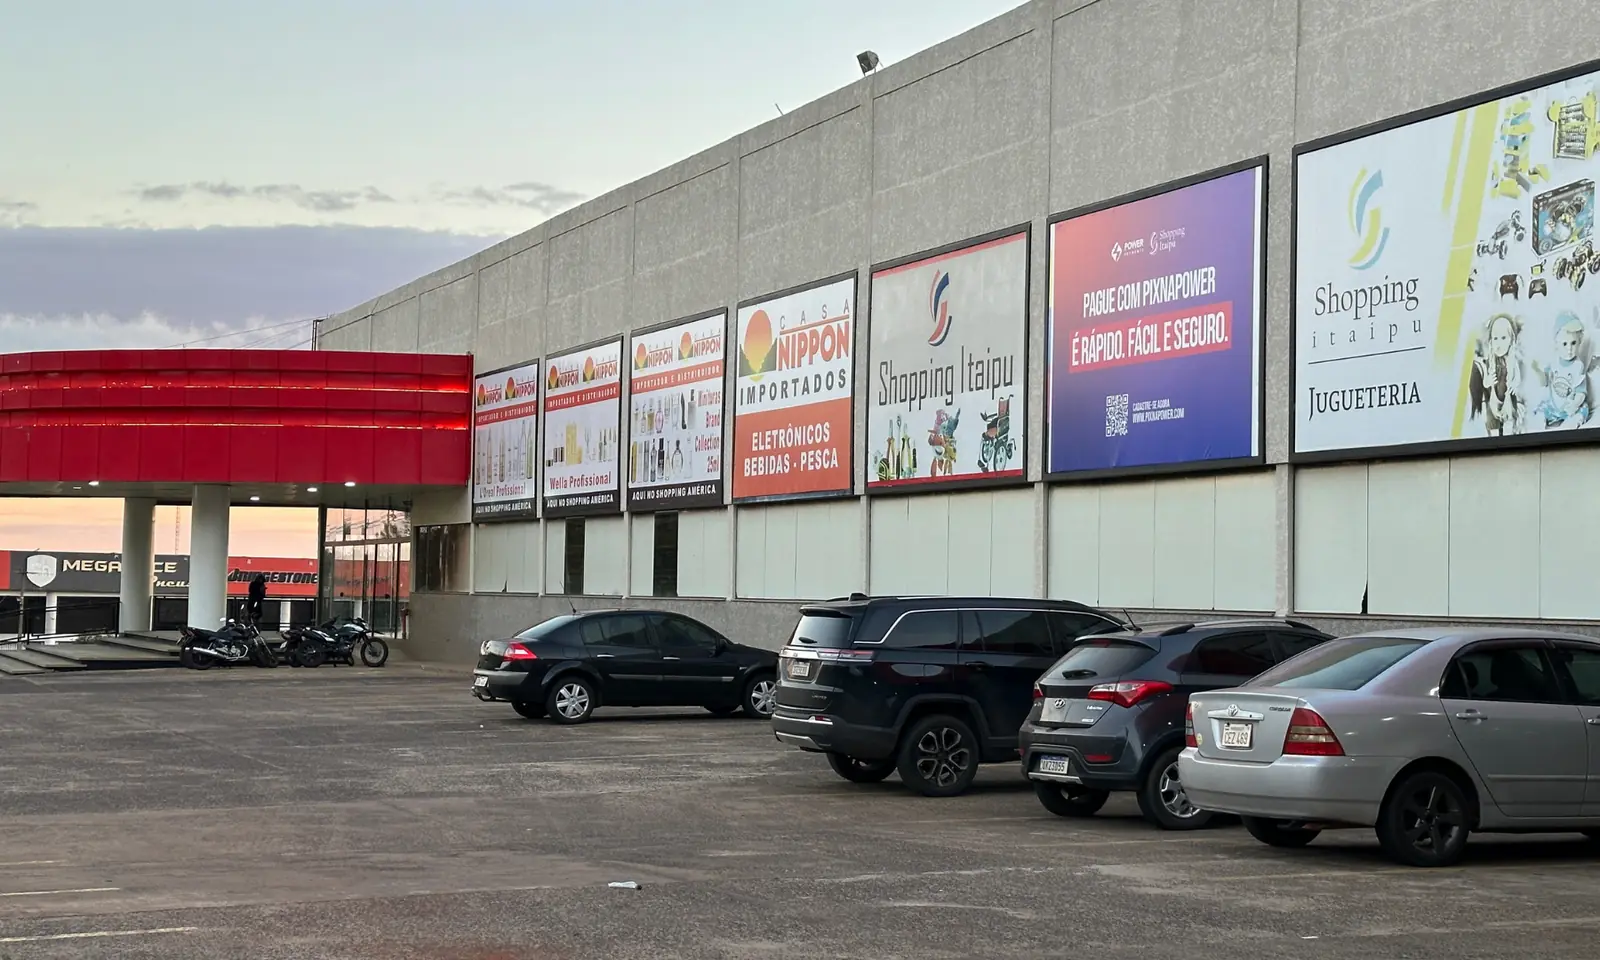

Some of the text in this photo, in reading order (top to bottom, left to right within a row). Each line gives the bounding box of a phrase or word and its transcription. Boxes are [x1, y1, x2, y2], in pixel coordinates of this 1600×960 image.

[1124, 238, 1144, 251] POWER
[1159, 227, 1185, 240] Shopping
[1083, 266, 1216, 318] PAGUE COM PIXNAPOWER
[1314, 274, 1419, 320] Shopping
[780, 298, 850, 330] CASA
[693, 337, 720, 357] NIPPON
[778, 320, 850, 372] NIPPON
[1071, 331, 1080, 366] É
[1128, 320, 1161, 358] FÁCIL
[1163, 321, 1172, 352] E
[1174, 311, 1228, 350] SEGURO.
[1312, 319, 1422, 348] itaipu
[595, 361, 617, 380] NIPPON
[648, 348, 673, 368] NIPPON
[740, 368, 847, 406] IMPORTADOS
[878, 346, 1014, 412] Shopping Itaipu
[1308, 382, 1422, 421] JUGUETERIA
[706, 410, 720, 428] Brand
[752, 421, 830, 452] ELETRÔNICOS
[744, 453, 790, 477] BEBIDAS
[800, 447, 839, 472] PESCA
[550, 471, 611, 490] Wella Profissional
[632, 484, 716, 500] AQUI NO SHOPPING AMÉRICA
[490, 503, 510, 512] SHOPPING
[547, 499, 558, 508] AQUI
[566, 496, 590, 506] SHOPPING
